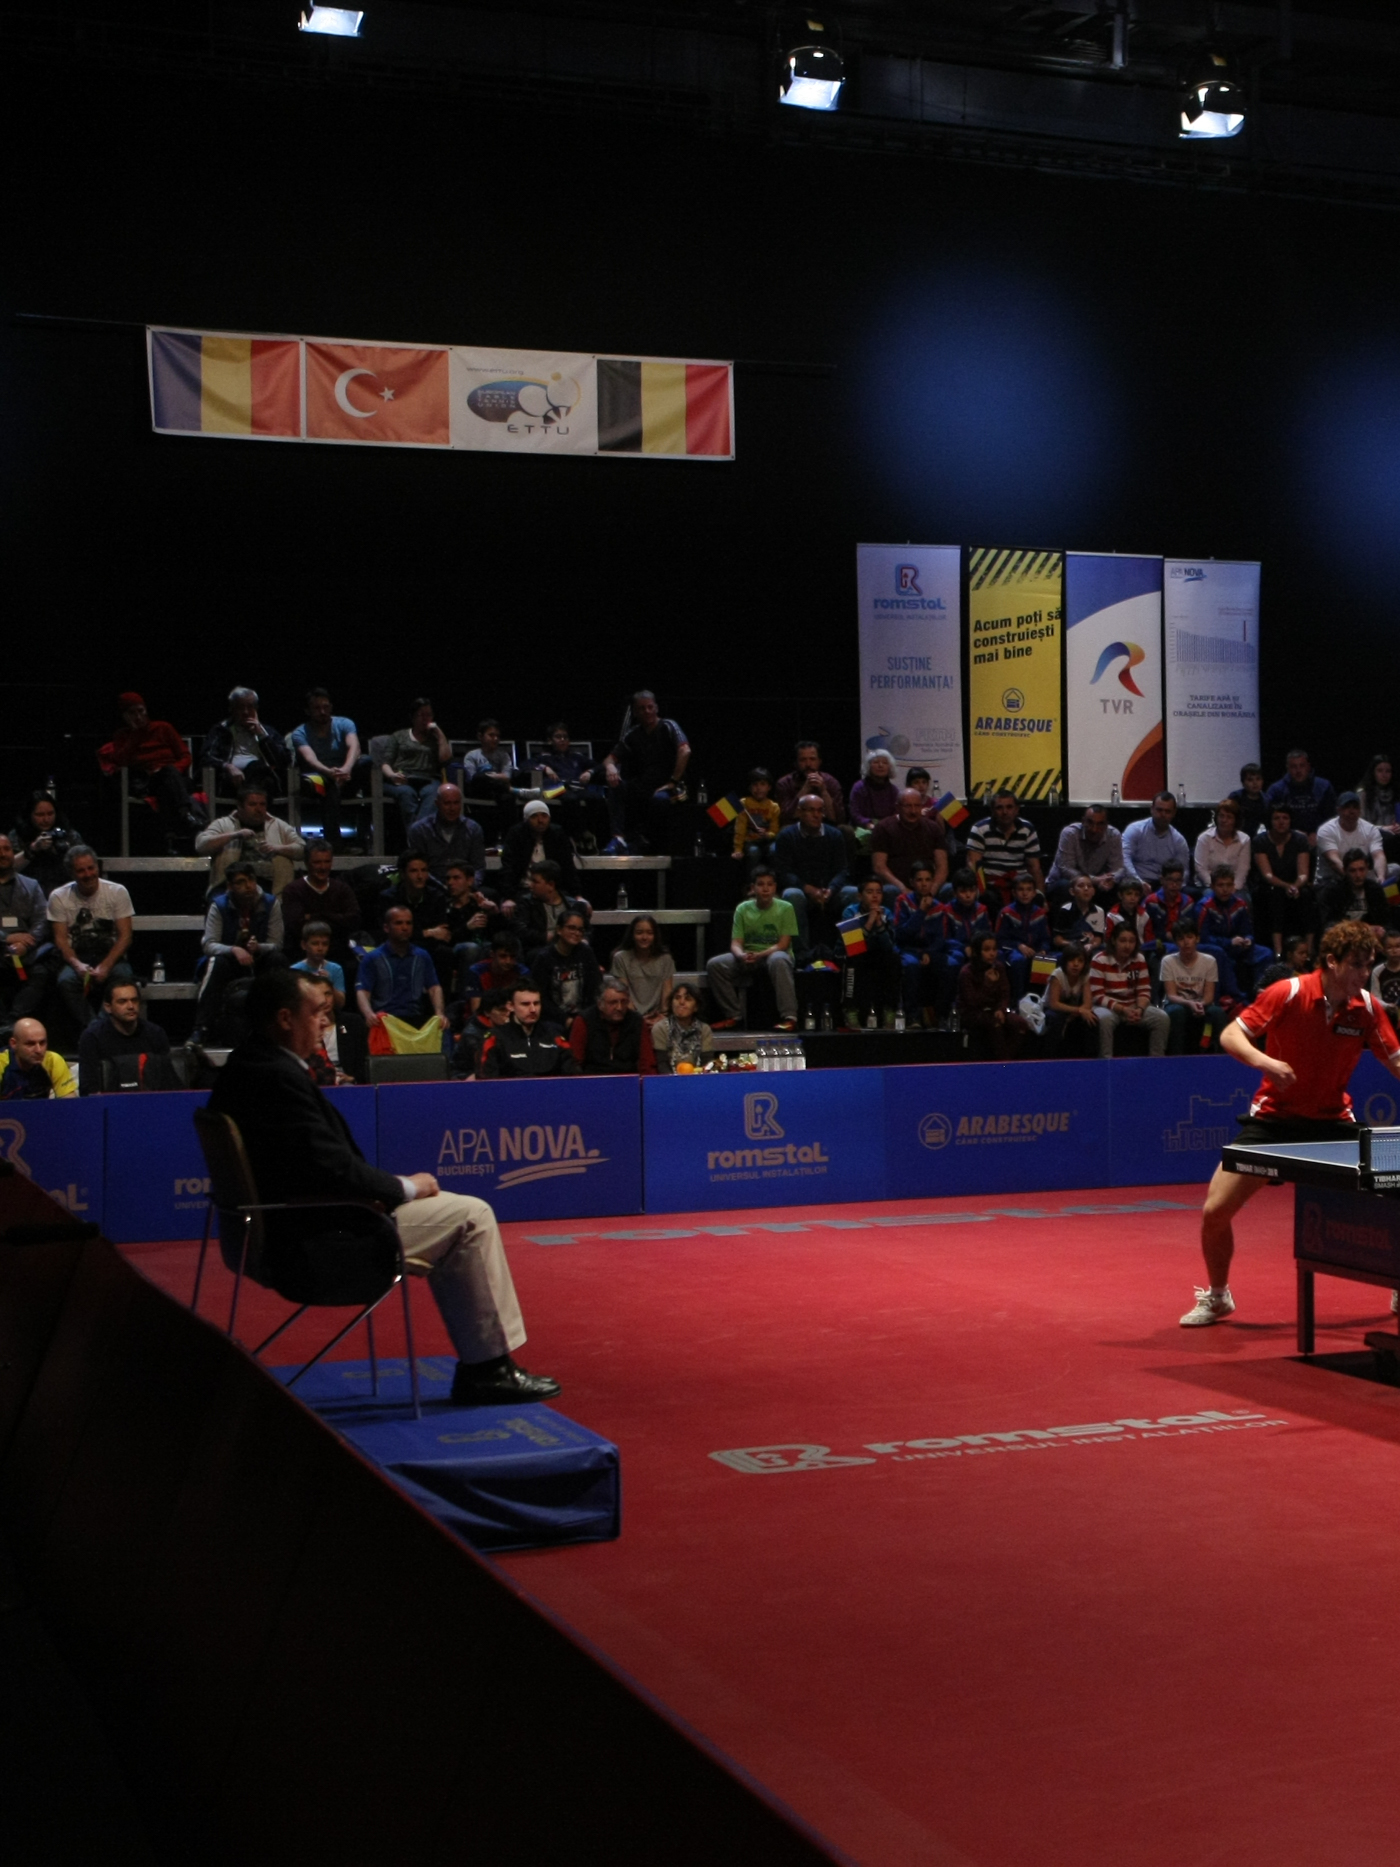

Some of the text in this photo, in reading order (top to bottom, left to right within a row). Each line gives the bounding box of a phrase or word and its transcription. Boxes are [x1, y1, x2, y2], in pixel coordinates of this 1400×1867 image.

[507, 424, 570, 435] ETTU
[973, 617, 1012, 633] Acum
[973, 646, 1033, 665] mai bine
[1099, 699, 1134, 715] TVR
[975, 716, 1053, 733] ARABESQUE
[955, 1111, 1071, 1137] ARABESQUE
[437, 1127, 495, 1164] APA
[891, 1442, 1069, 1462] UNIVERSUL
